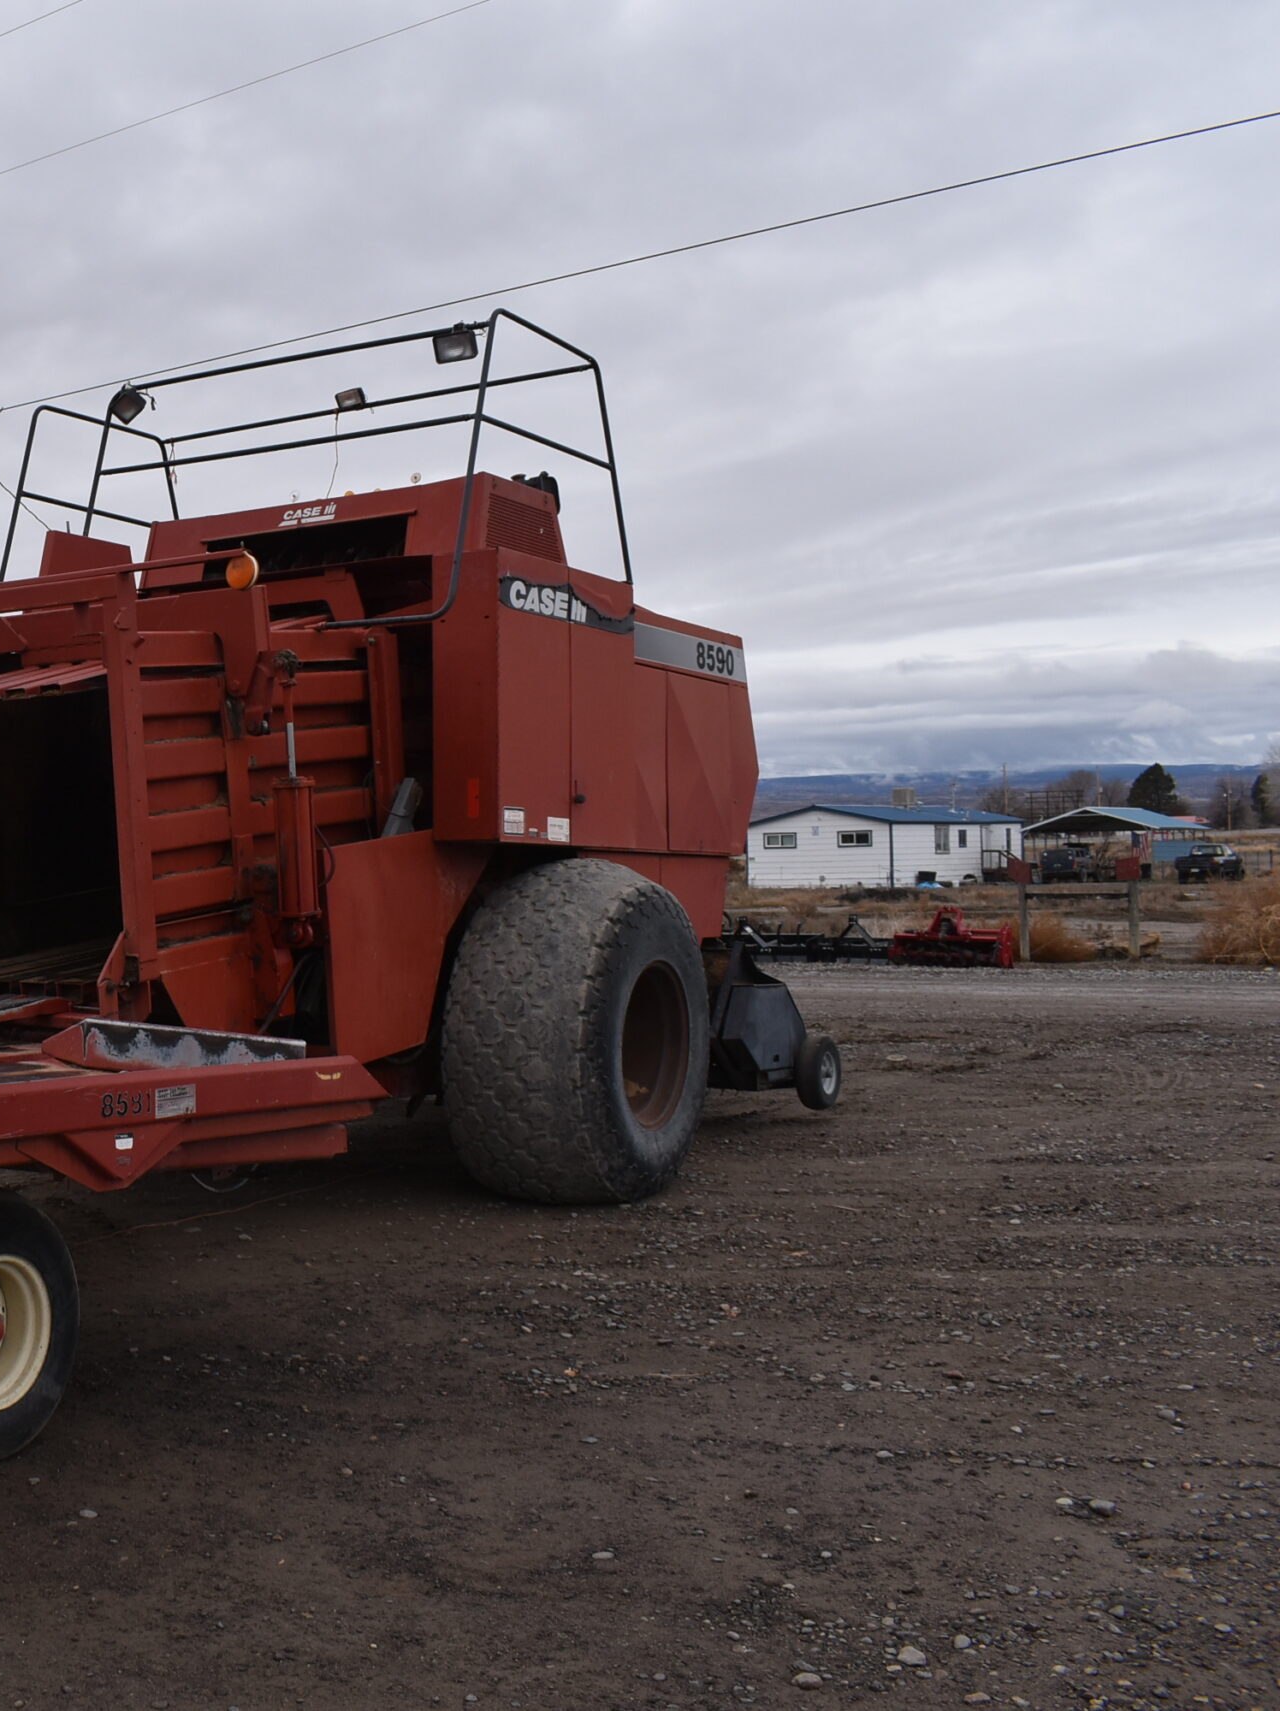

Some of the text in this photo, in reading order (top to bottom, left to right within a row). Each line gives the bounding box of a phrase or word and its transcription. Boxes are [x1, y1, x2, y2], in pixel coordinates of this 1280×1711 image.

[283, 505, 322, 521] CASE
[509, 580, 569, 619] CASE
[696, 641, 734, 676] 8590
